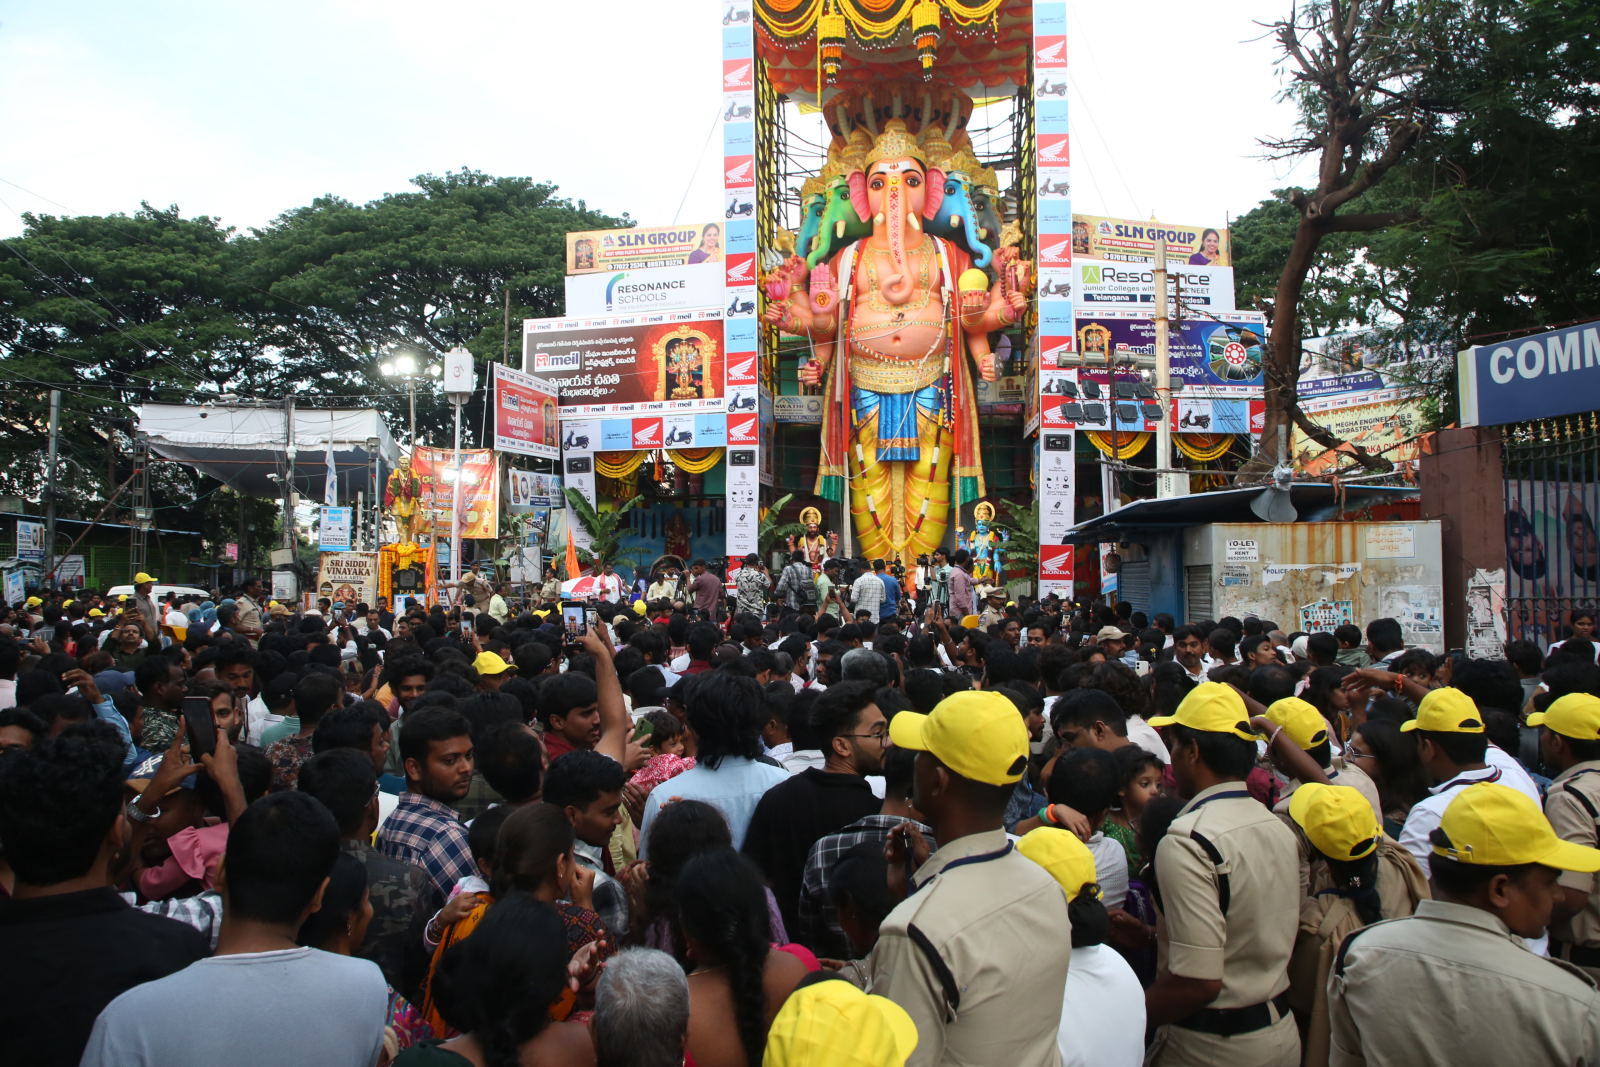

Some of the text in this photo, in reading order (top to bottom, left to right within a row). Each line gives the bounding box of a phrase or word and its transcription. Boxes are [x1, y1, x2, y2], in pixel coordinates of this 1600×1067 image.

[617, 230, 696, 246] SLN GROUP
[1115, 224, 1143, 239] SLN
[1147, 228, 1196, 244] GROUP
[1102, 268, 1210, 285] Resoance
[618, 280, 685, 293] RESONANCE
[618, 293, 667, 304] SCHOOLS
[1131, 345, 1154, 354] meil
[552, 353, 579, 365] meil
[326, 567, 370, 576] VINAYAKA
